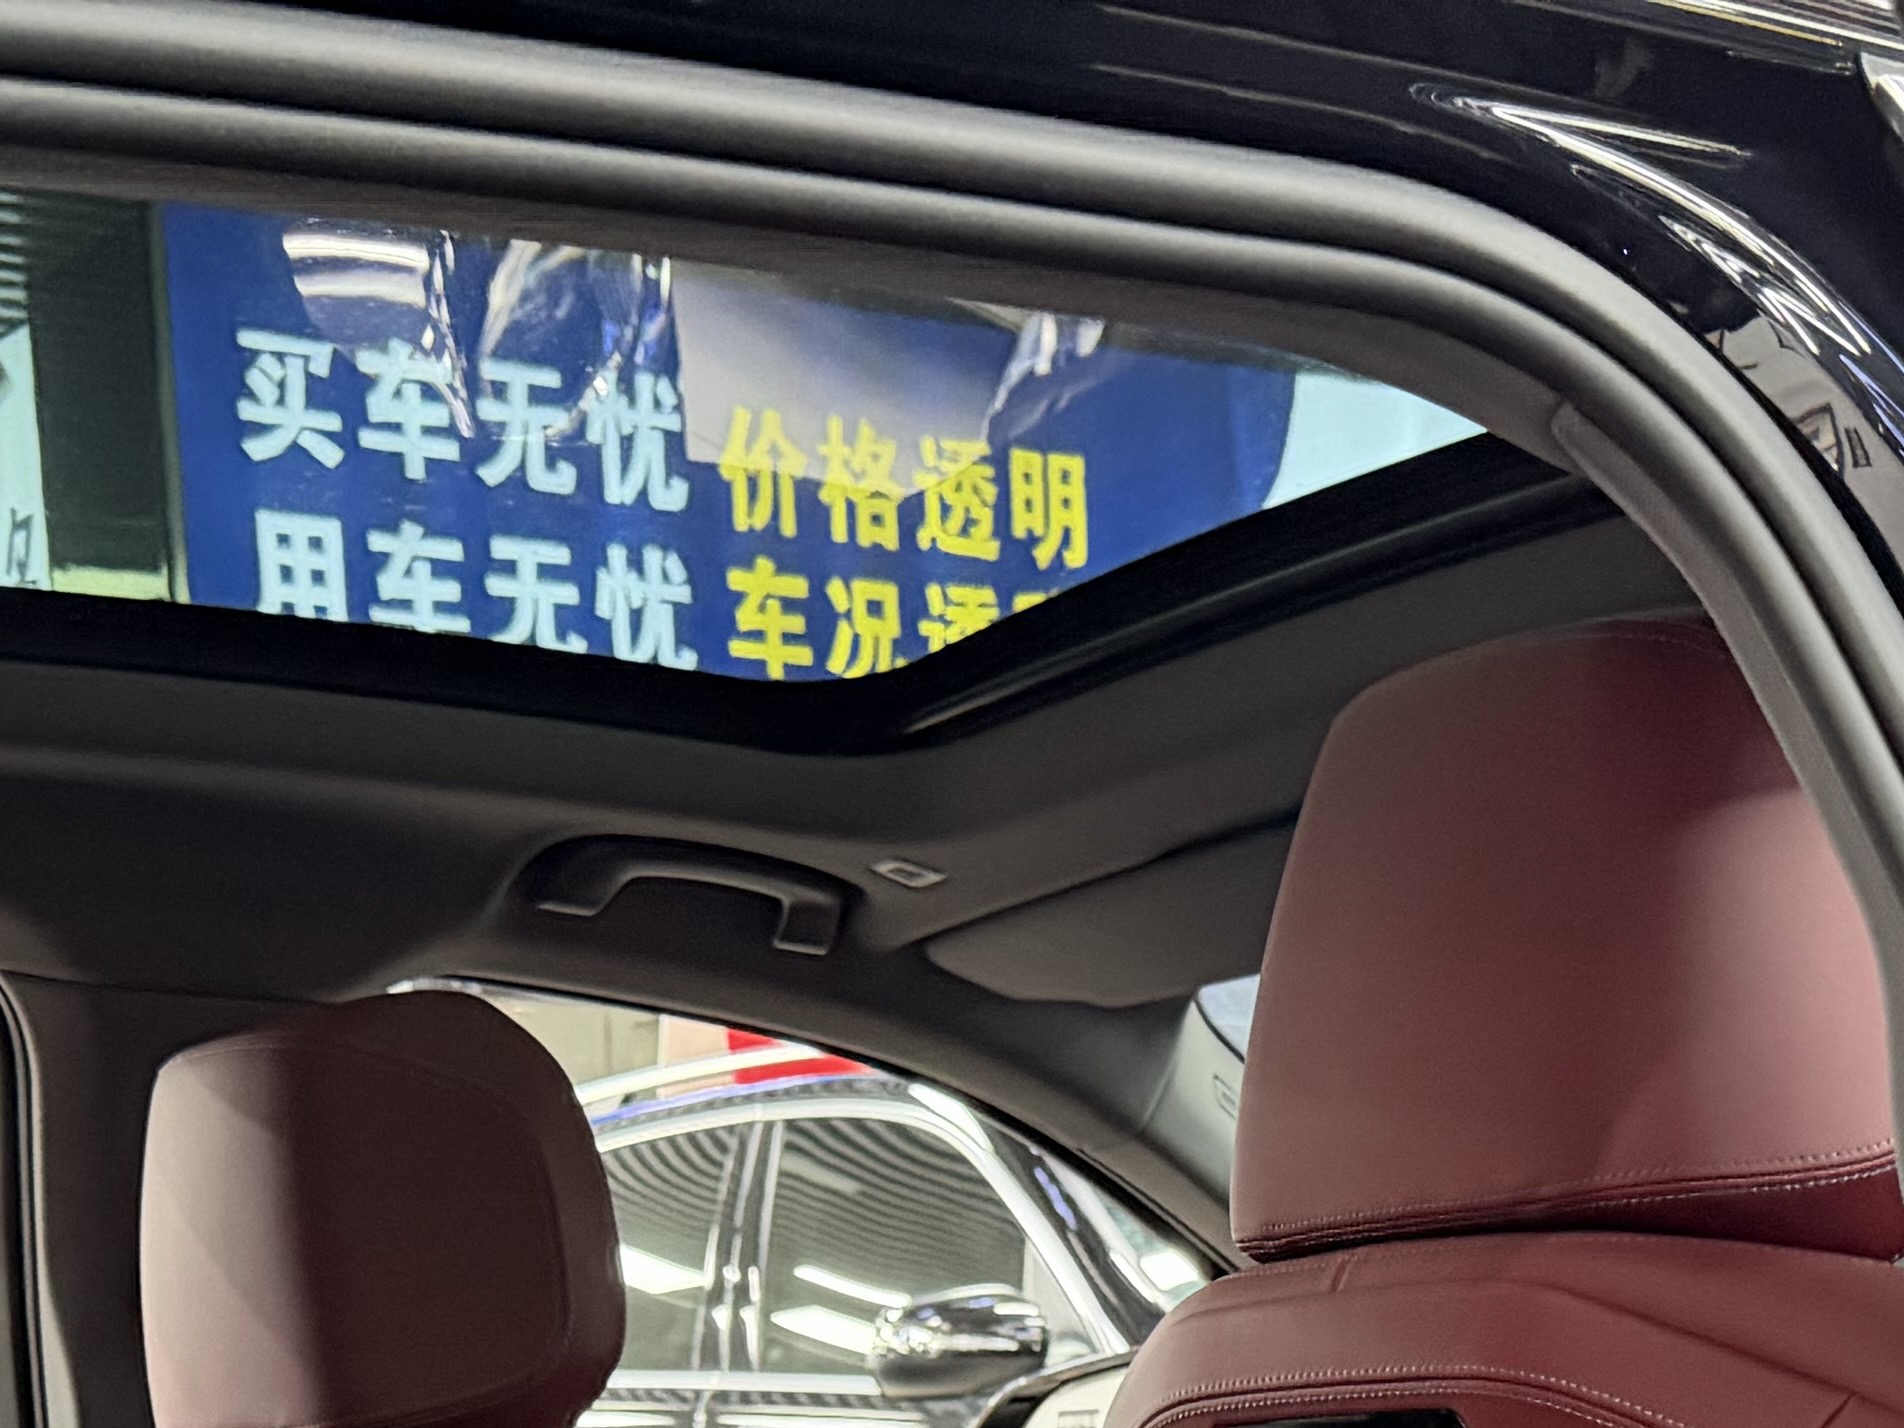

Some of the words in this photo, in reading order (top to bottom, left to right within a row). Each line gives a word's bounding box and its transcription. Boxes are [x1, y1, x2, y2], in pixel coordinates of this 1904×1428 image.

[235, 328, 690, 513] 买车无忧
[718, 405, 1089, 570] 价格透明
[254, 509, 698, 671] 用车无忧
[725, 555, 1054, 681] 车况透
